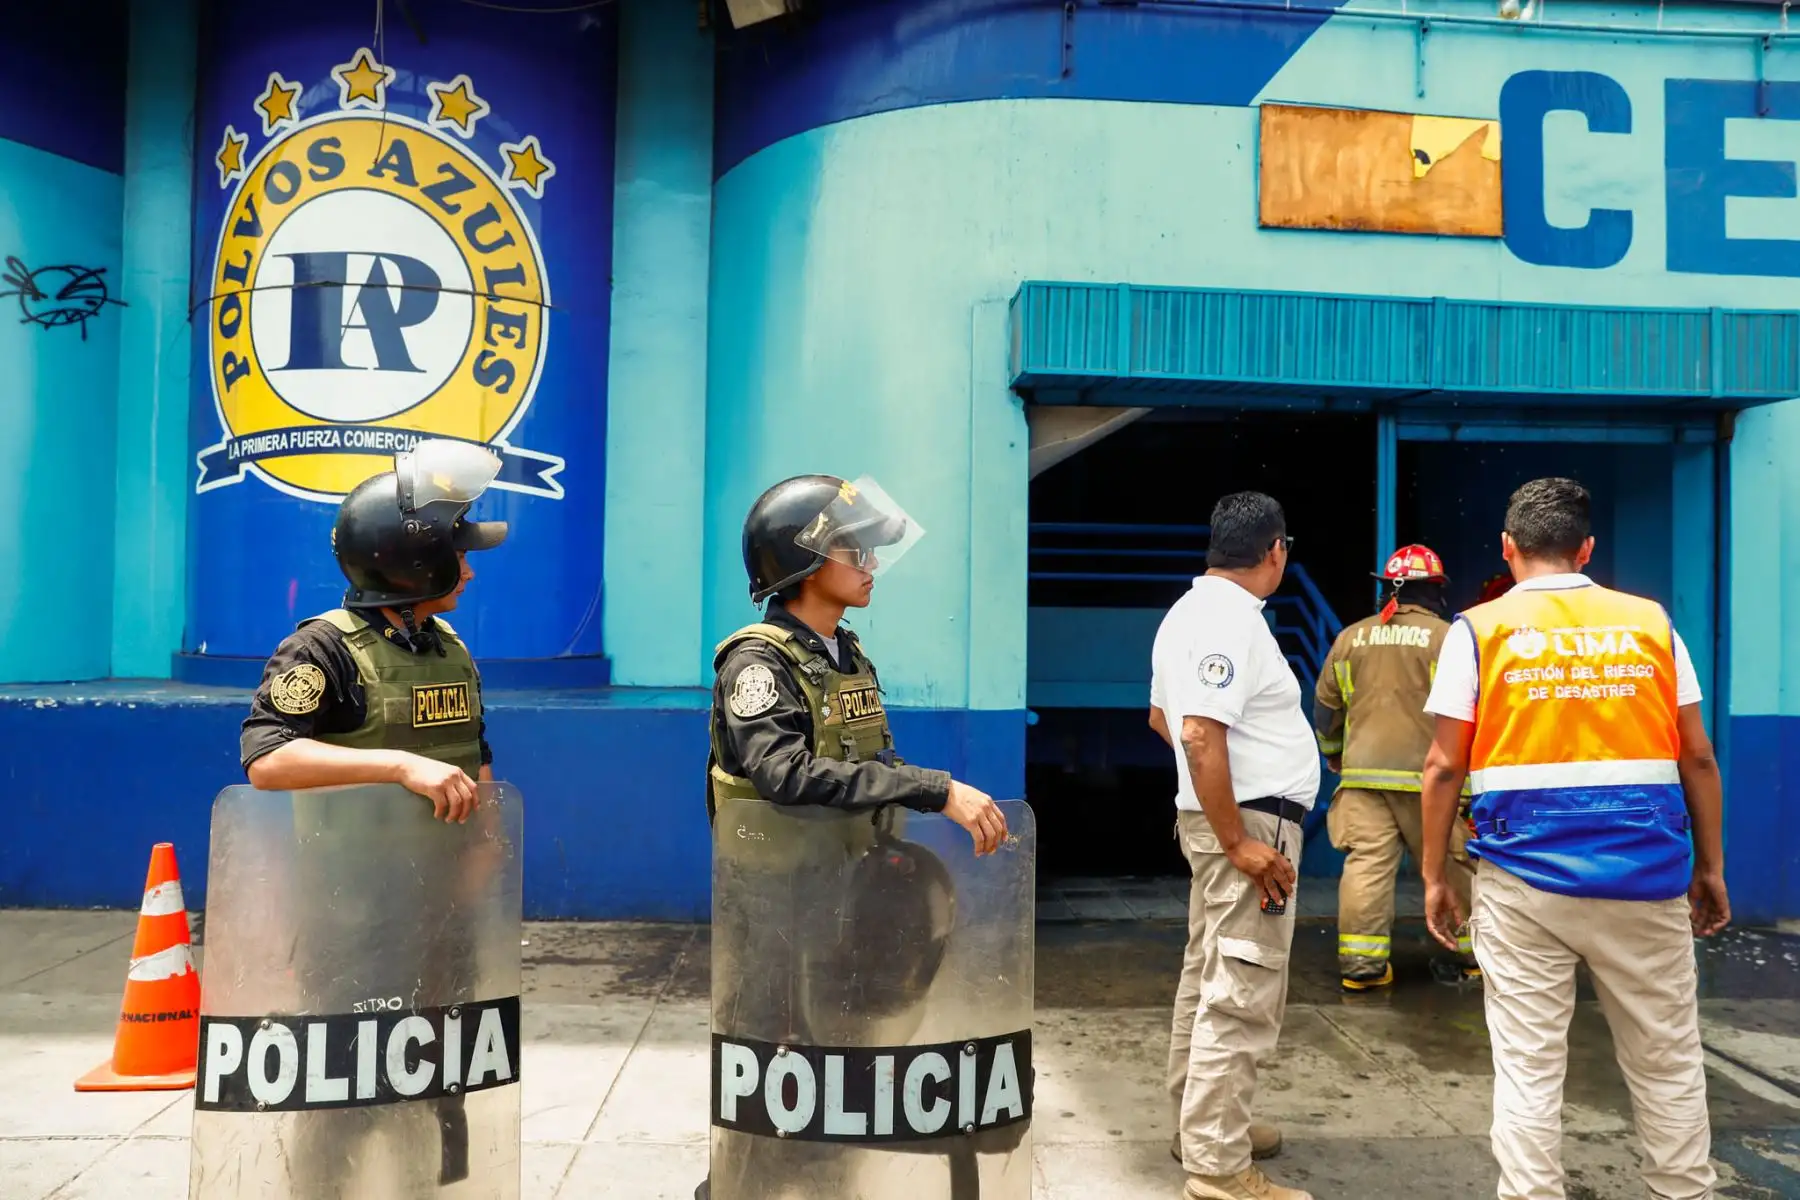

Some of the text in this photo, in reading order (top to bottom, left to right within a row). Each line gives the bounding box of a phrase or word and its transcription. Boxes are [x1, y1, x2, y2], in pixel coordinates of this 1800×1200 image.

[219, 137, 528, 394] POLVOS AZULES
[228, 430, 422, 460] LA PRIMERA FUERZA COMERCIA
[1352, 624, 1432, 648] J. RAMOS
[1553, 631, 1642, 657] LIMA
[1504, 664, 1655, 683] GESTIÓN DEL RIESGO
[416, 687, 468, 722] POLICIA
[1528, 684, 1636, 700] DE DESASTRES
[203, 1008, 512, 1105] POLICIA
[720, 1042, 1024, 1136] POLICIA
